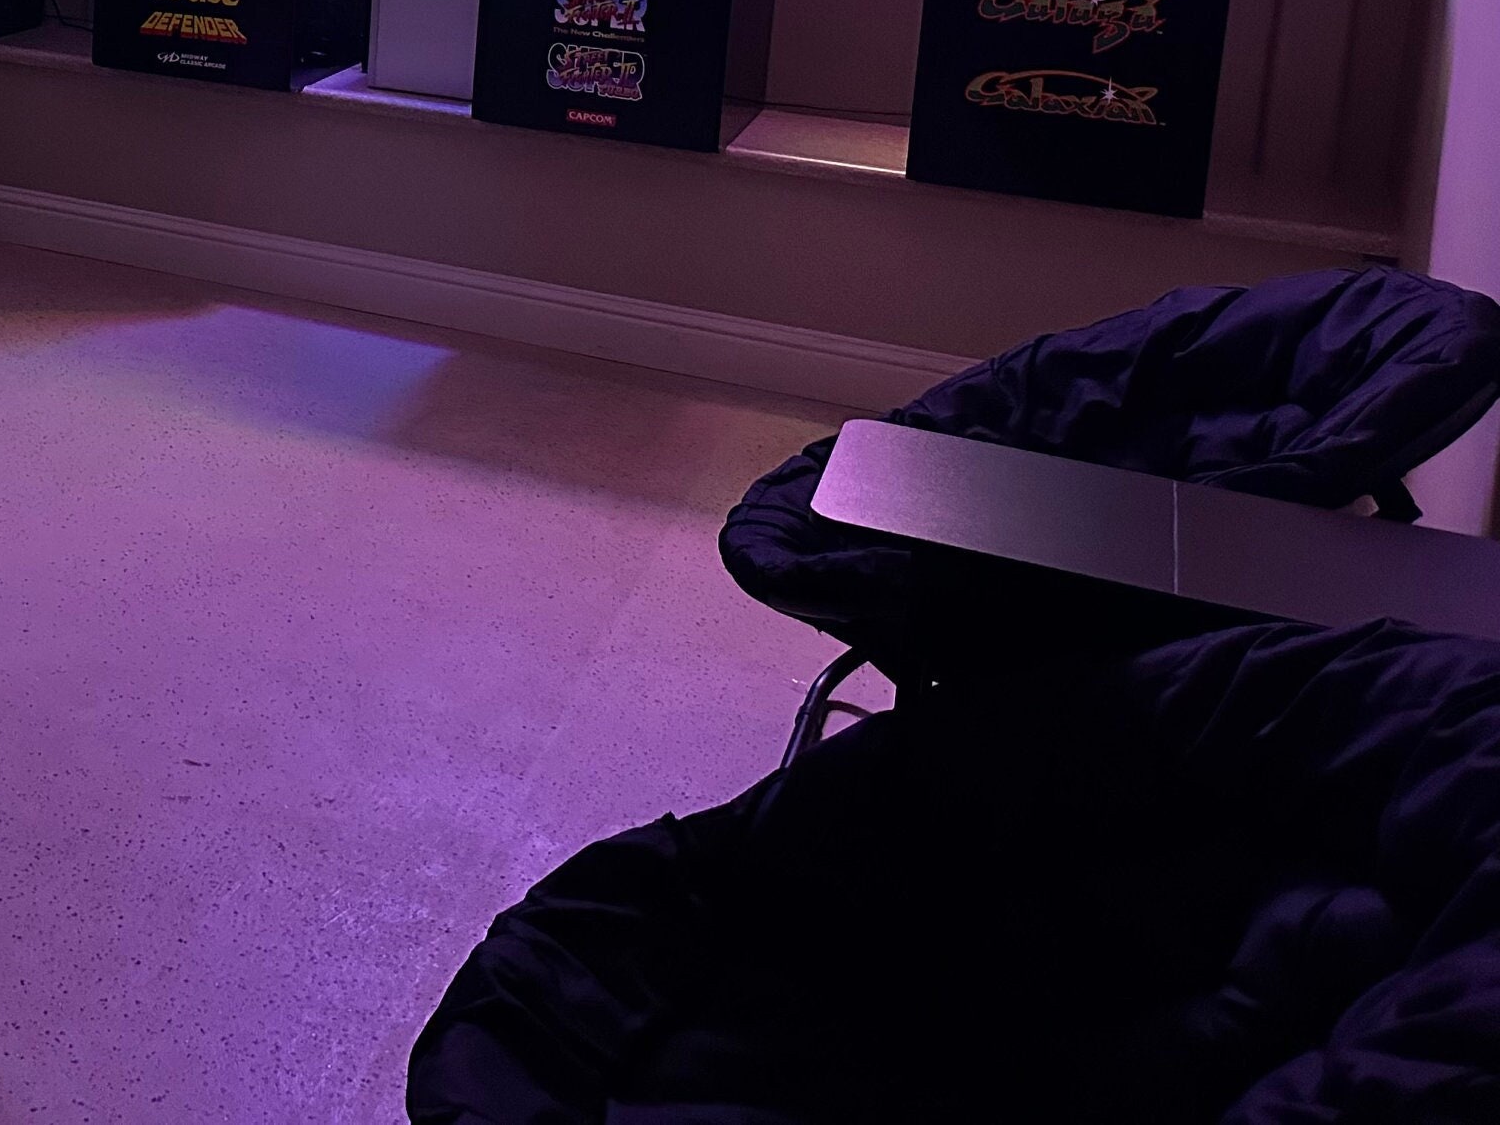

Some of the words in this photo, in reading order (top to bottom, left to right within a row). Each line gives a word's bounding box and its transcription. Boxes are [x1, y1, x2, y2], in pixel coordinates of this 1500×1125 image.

[139, 11, 248, 45] DEFENDER
[553, 26, 570, 35] The
[570, 27, 591, 37] New
[568, 110, 613, 124] CAPCOM
